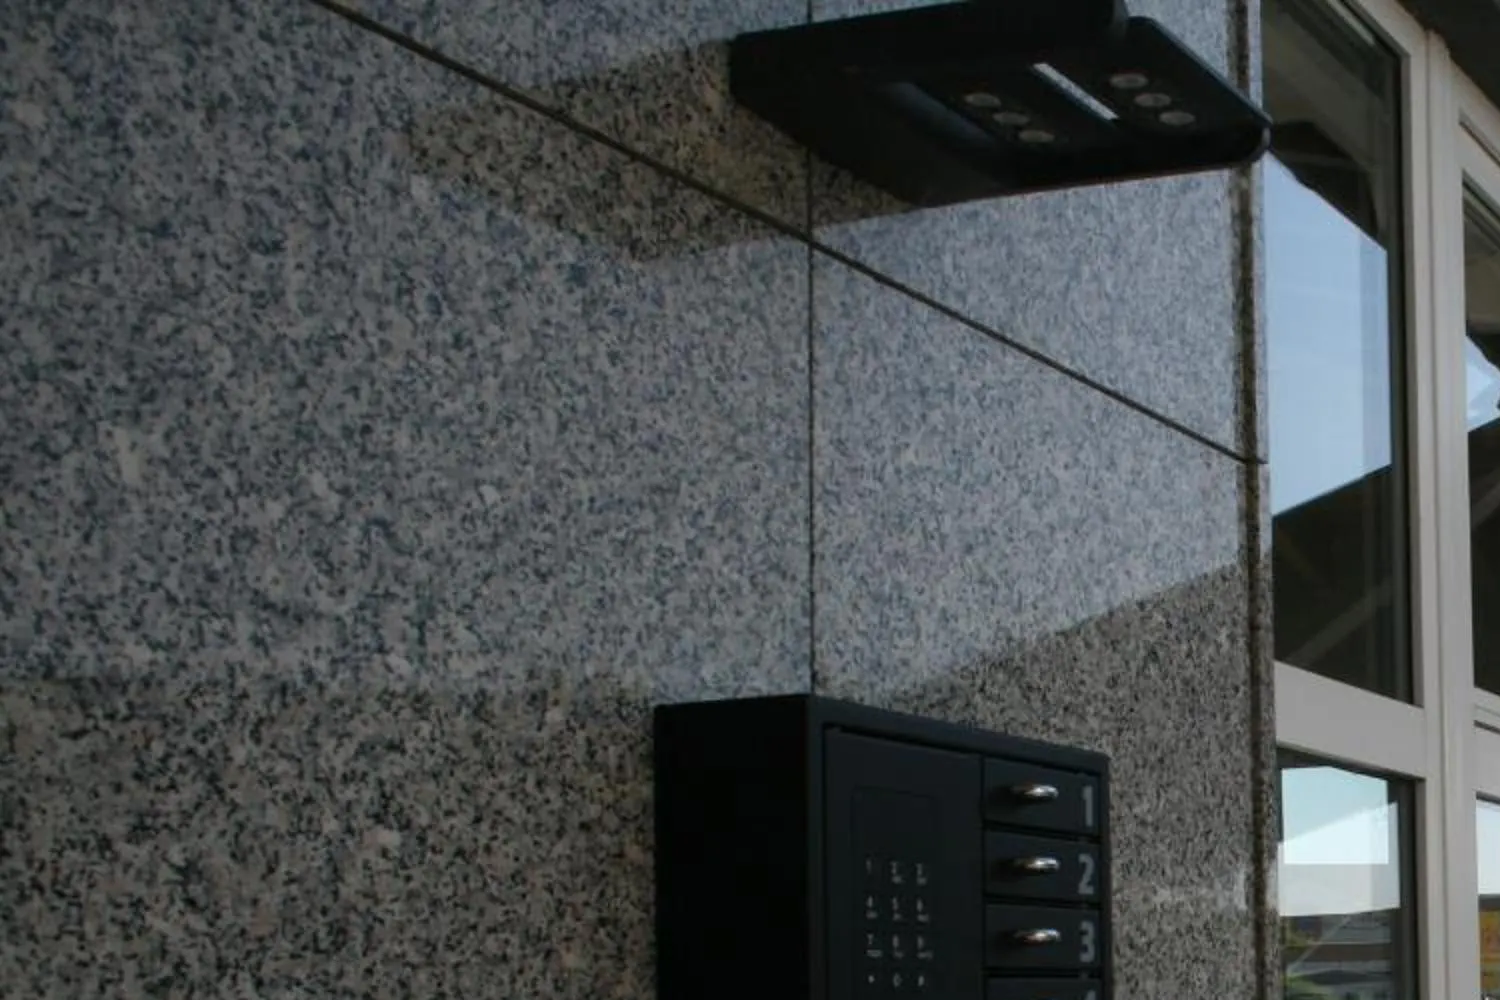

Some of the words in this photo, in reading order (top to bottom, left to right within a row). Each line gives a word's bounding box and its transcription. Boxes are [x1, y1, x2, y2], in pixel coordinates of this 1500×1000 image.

[1082, 784, 1094, 828] 1
[1077, 852, 1096, 896] 2
[1078, 919, 1096, 964] 3
